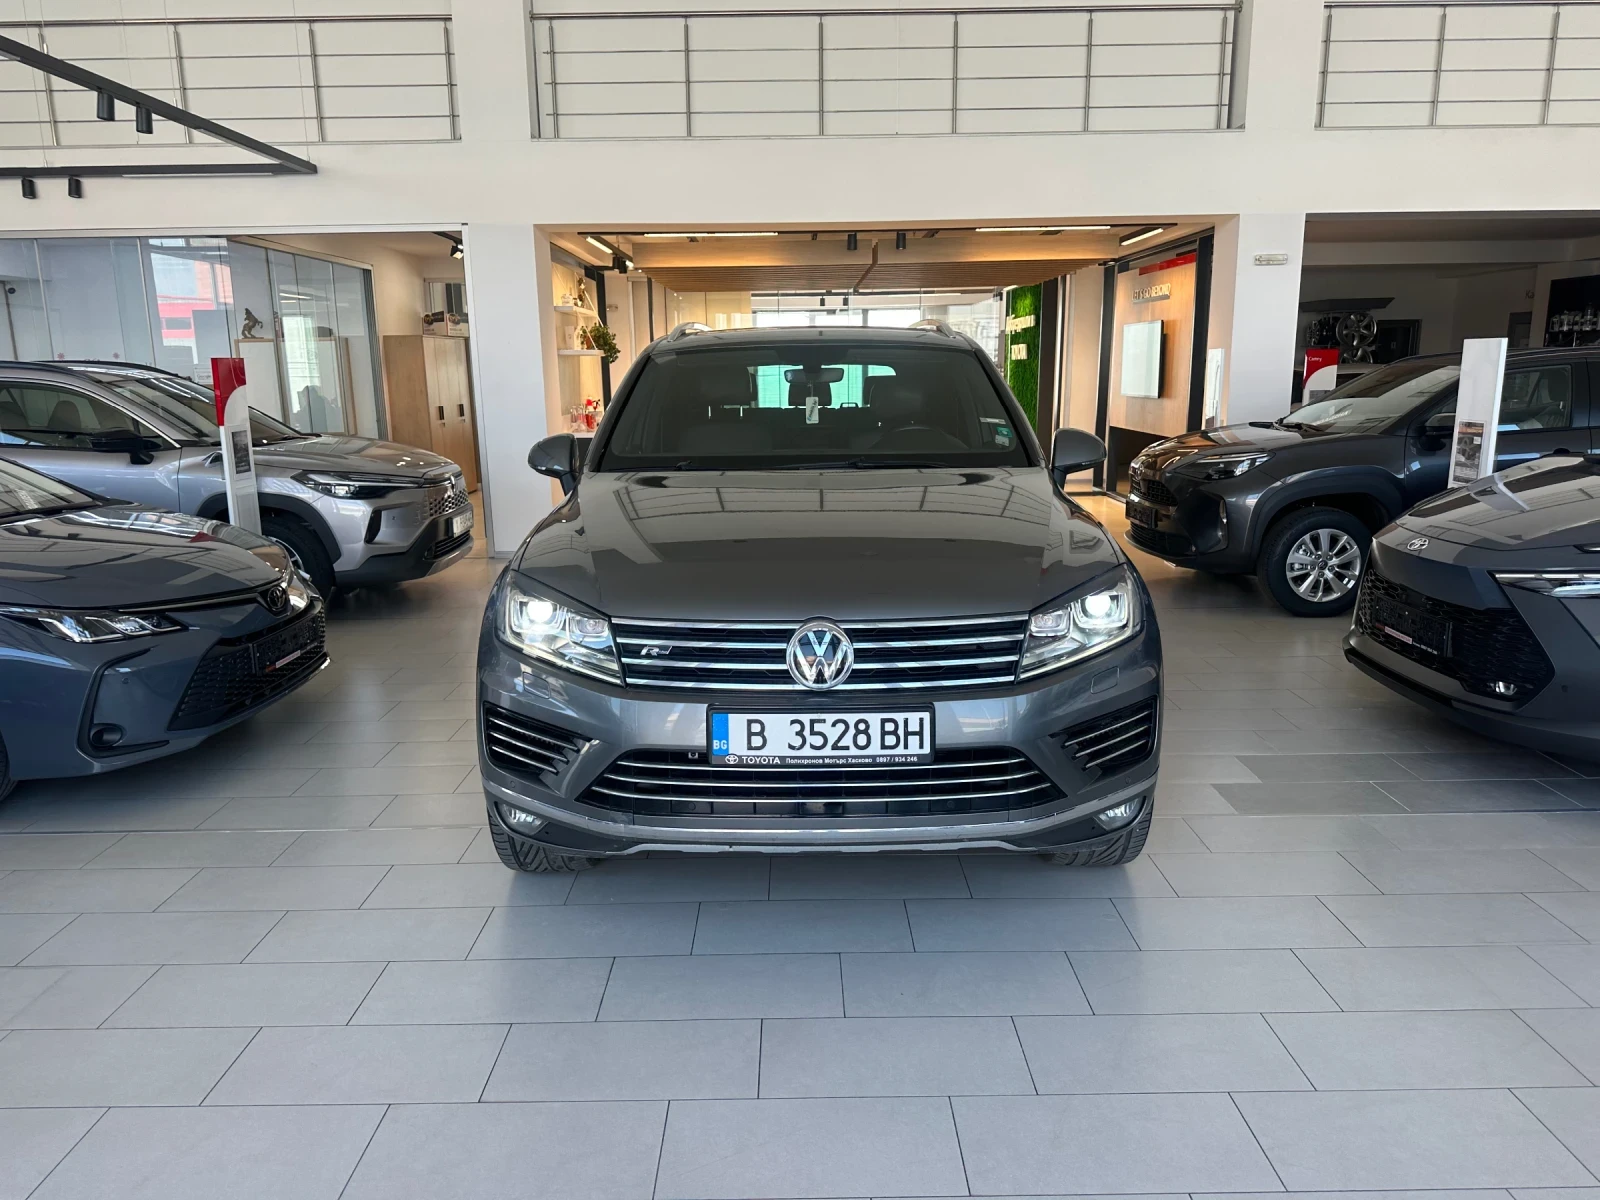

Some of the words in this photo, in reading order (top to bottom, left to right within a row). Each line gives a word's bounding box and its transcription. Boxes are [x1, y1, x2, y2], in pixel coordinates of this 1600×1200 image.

[713, 739, 728, 749] BG
[746, 719, 767, 750] B
[787, 718, 871, 751] 3528
[880, 717, 924, 750] BH
